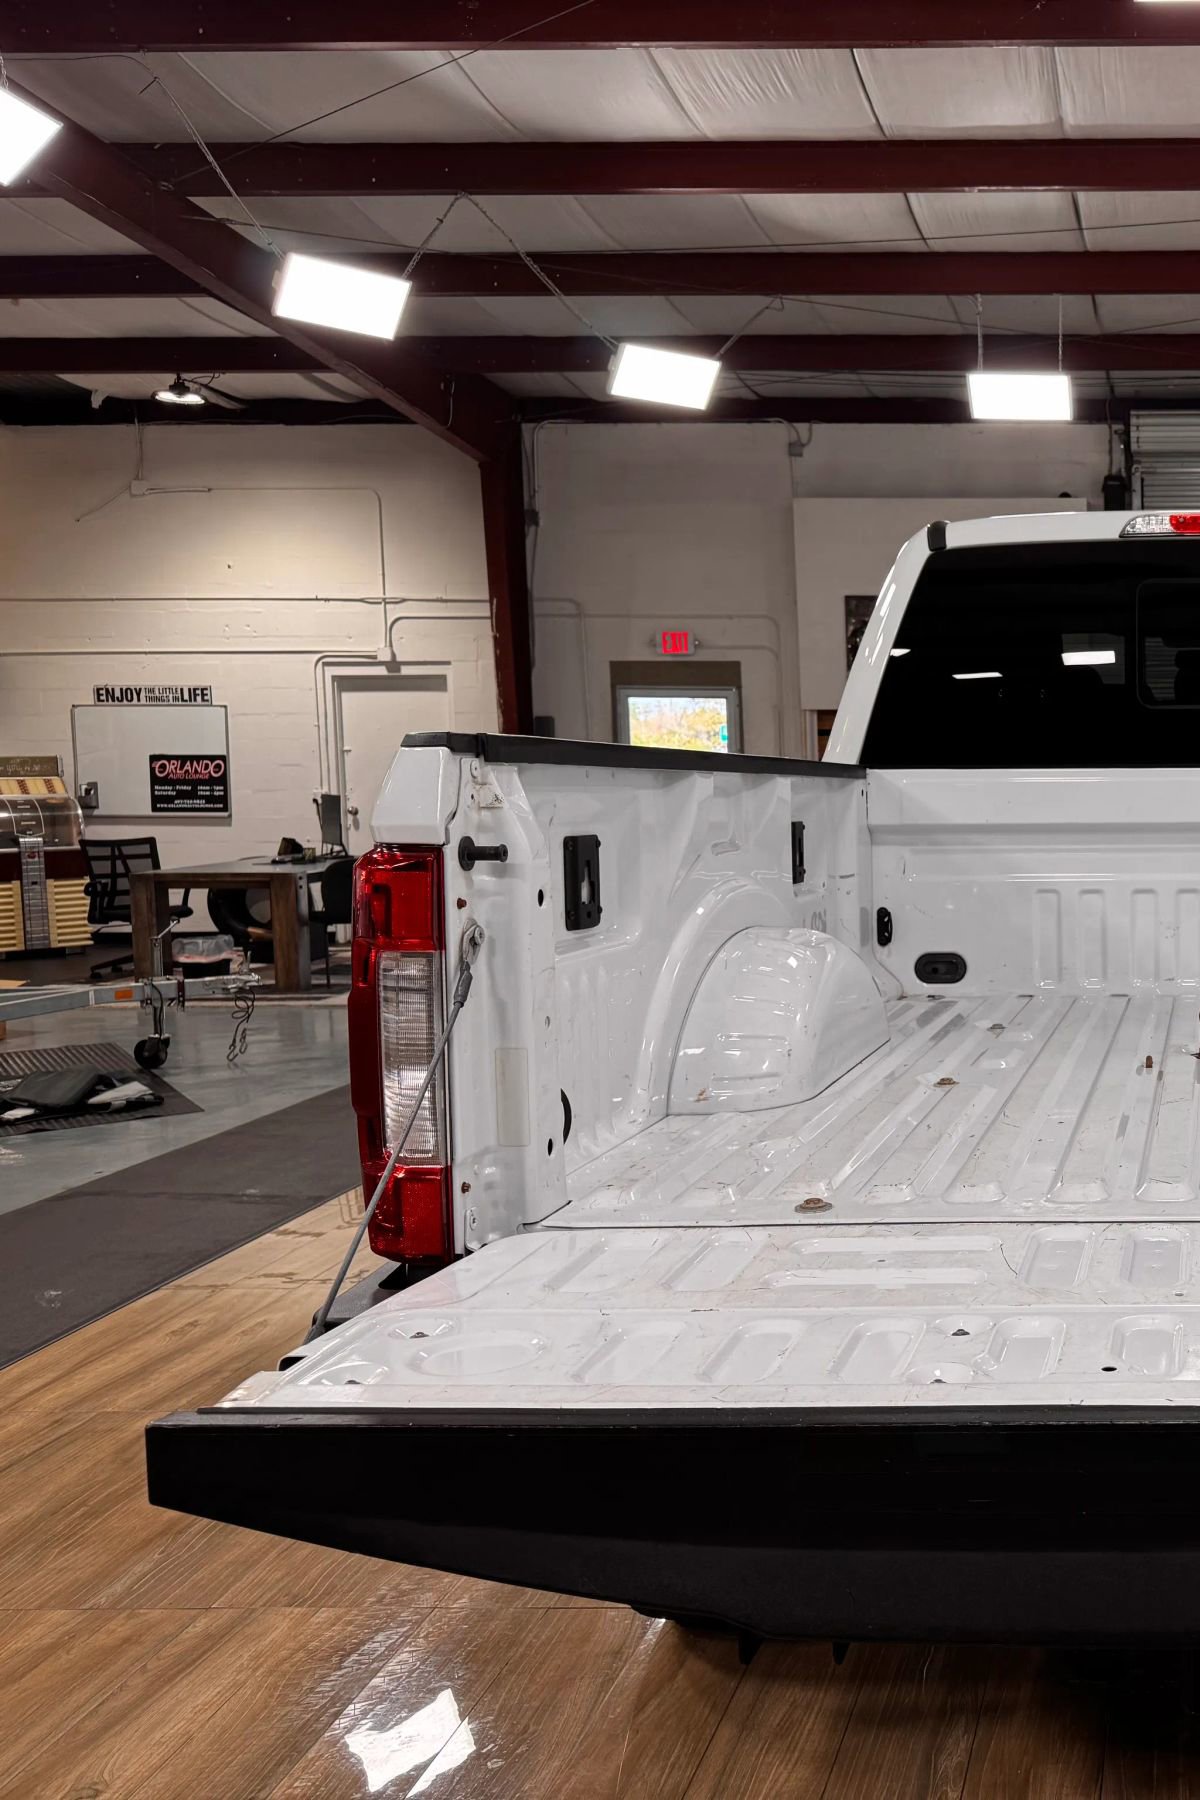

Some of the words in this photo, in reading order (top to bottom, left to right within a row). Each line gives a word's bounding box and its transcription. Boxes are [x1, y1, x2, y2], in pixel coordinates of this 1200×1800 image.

[662, 631, 689, 655] EXIT
[95, 687, 143, 703] ENJOY
[144, 687, 156, 695] THE
[158, 687, 179, 695] LITTLE
[144, 695, 170, 703] THINGS
[172, 695, 180, 703] IN
[180, 687, 209, 703] LIFE
[155, 759, 225, 777] ORLANDO
